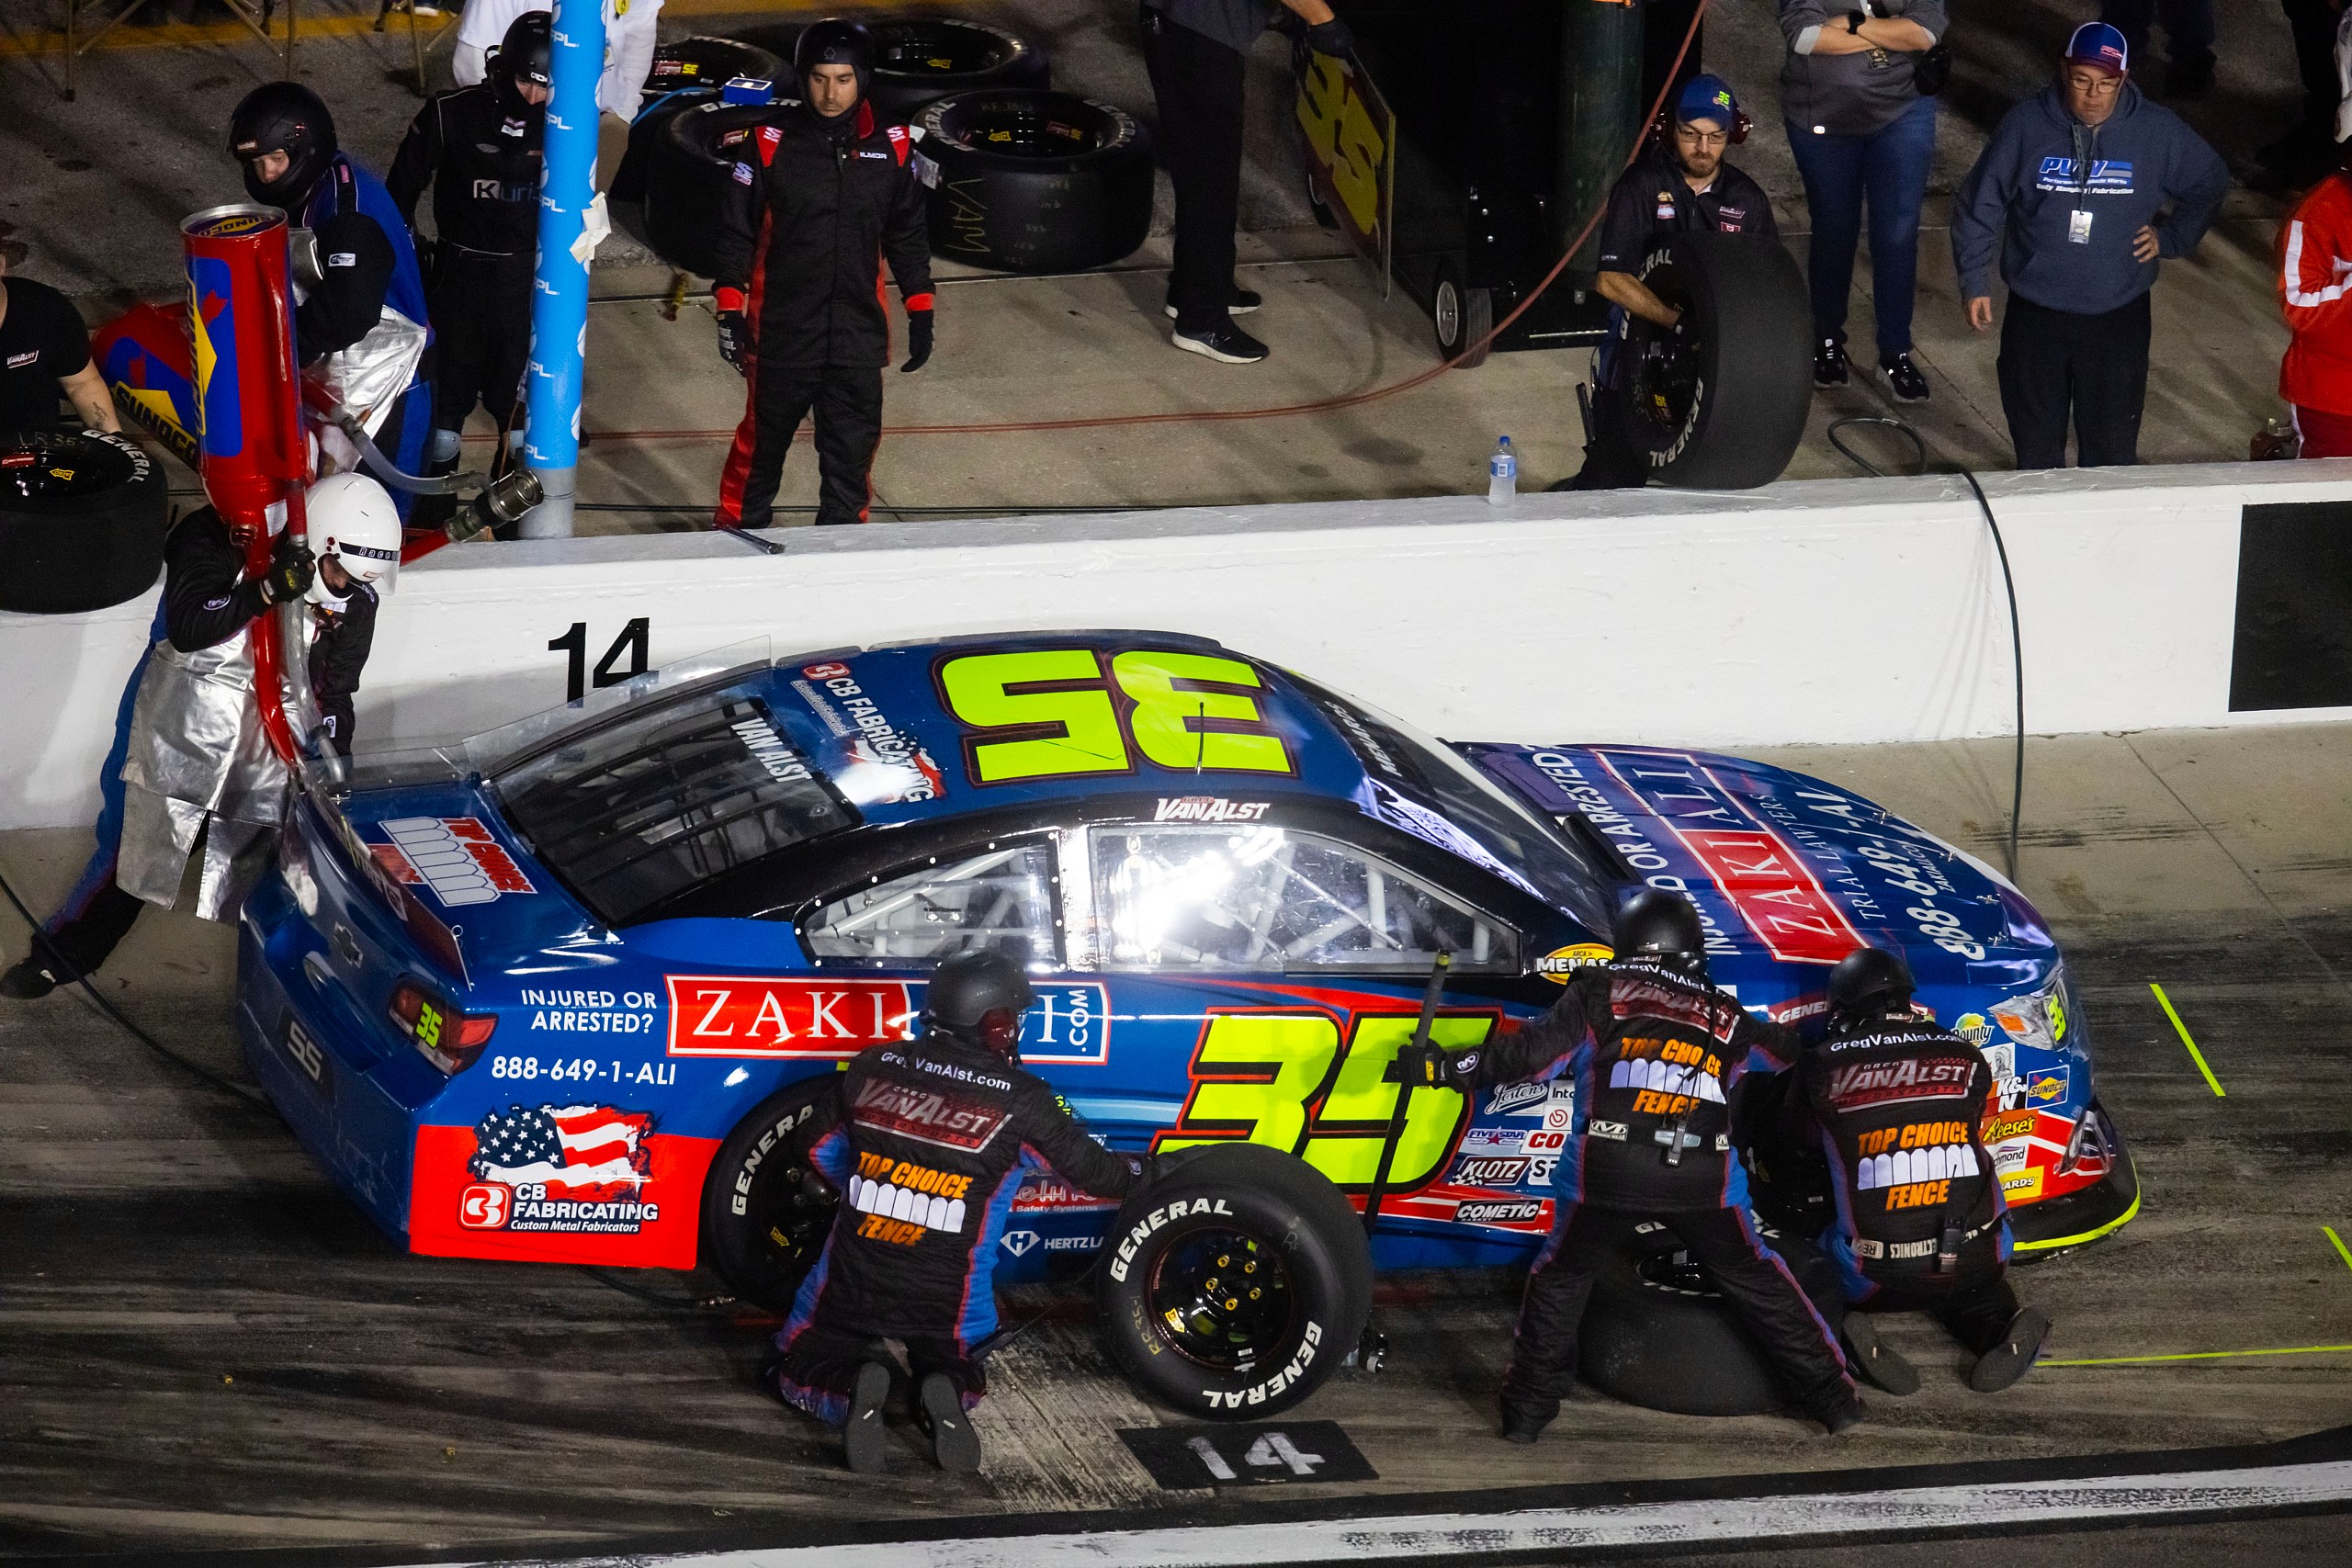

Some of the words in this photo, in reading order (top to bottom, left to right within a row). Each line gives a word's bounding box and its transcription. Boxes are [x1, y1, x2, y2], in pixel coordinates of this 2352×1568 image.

[1719, 91, 1730, 105] 35
[1649, 376, 1703, 468] GENERAL
[82, 429, 151, 483] GENERAL
[548, 617, 660, 708] 14
[825, 677, 863, 697] CB
[942, 649, 1291, 782] 35
[730, 717, 784, 750] VAN
[842, 697, 935, 803] FABRICATING
[754, 750, 812, 783] ALST
[1154, 798, 1271, 822] VANALST
[1633, 767, 1744, 826] ALI
[1749, 793, 1842, 862] LAWYERS
[1616, 841, 1669, 870] OR
[1704, 838, 1838, 938] ZAKI
[1826, 865, 1888, 919] TRIAL
[521, 989, 614, 1008] INJURED
[623, 991, 657, 1009] OR
[414, 1002, 443, 1049] 35
[530, 1011, 654, 1034] ARRESTED?
[1069, 989, 1090, 1054] .COM
[287, 1021, 323, 1081] SS
[1660, 1039, 1724, 1078] CHOCE
[491, 1055, 677, 1086] 888-649-1-ALI
[880, 1052, 1011, 1091] GreVanAlst.com
[1830, 1059, 1965, 1100] VANALST
[1156, 1017, 1494, 1185] 35
[1484, 1082, 1548, 1115] Jostens
[2028, 1078, 2068, 1098] SUNOCO
[854, 1077, 991, 1134] VANALST
[1470, 1130, 1496, 1139] FIVE
[1498, 1131, 1527, 1140] STAR
[1858, 1128, 1899, 1156] TOP
[1899, 1122, 1969, 1149] CHOICE
[1983, 1116, 2036, 1142] Reese's
[731, 1104, 814, 1216] GENERA
[856, 1151, 895, 1179] TOP
[889, 1162, 974, 1200] CHOICE
[1461, 1160, 1526, 1179] KLOTZ
[514, 1182, 548, 1201] CB
[1885, 1179, 1951, 1212] FENCE
[2002, 1177, 2036, 1191] ARDS
[513, 1201, 659, 1221] FABRICATING
[1016, 1205, 1051, 1213] Safety
[1052, 1204, 1099, 1213] Systems
[1457, 1203, 1539, 1220] COMETIC
[510, 1219, 549, 1232] Custom
[549, 1220, 582, 1232] Metal
[582, 1221, 640, 1233] Fabricators
[856, 1213, 928, 1247] FENCE
[1044, 1236, 1089, 1250] HERTZ
[1110, 1198, 1233, 1282] GENERAL
[1202, 1320, 1323, 1409] GENERAL
[1185, 1431, 1326, 1480] 14
